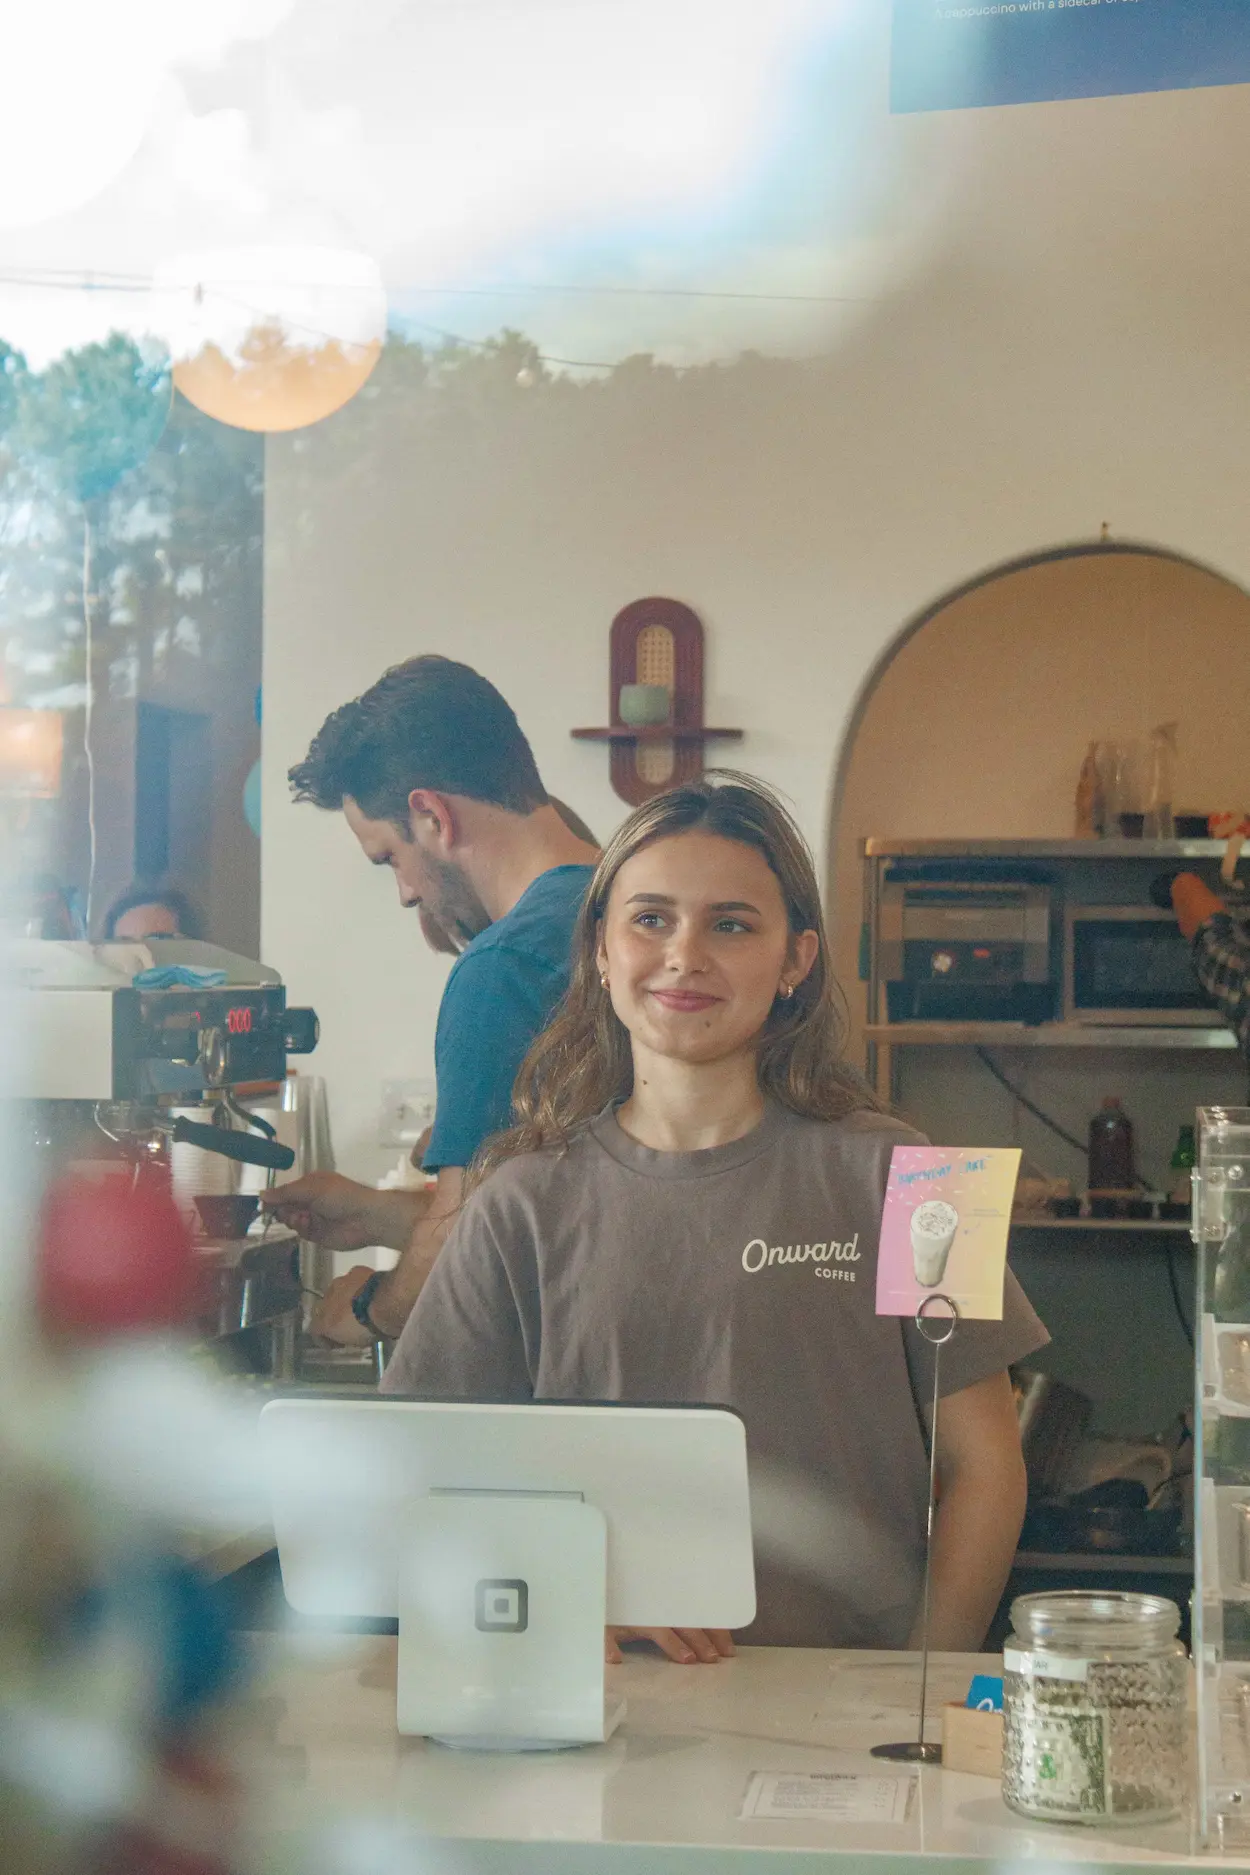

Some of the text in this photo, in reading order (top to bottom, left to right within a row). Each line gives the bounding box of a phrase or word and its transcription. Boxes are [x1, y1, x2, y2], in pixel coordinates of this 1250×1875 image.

[944, 4, 1016, 19] cappuccino
[1019, 0, 1045, 12] with
[1048, 1, 1055, 9] a
[741, 1232, 861, 1273] Onward
[814, 1267, 856, 1282] COFFEE
